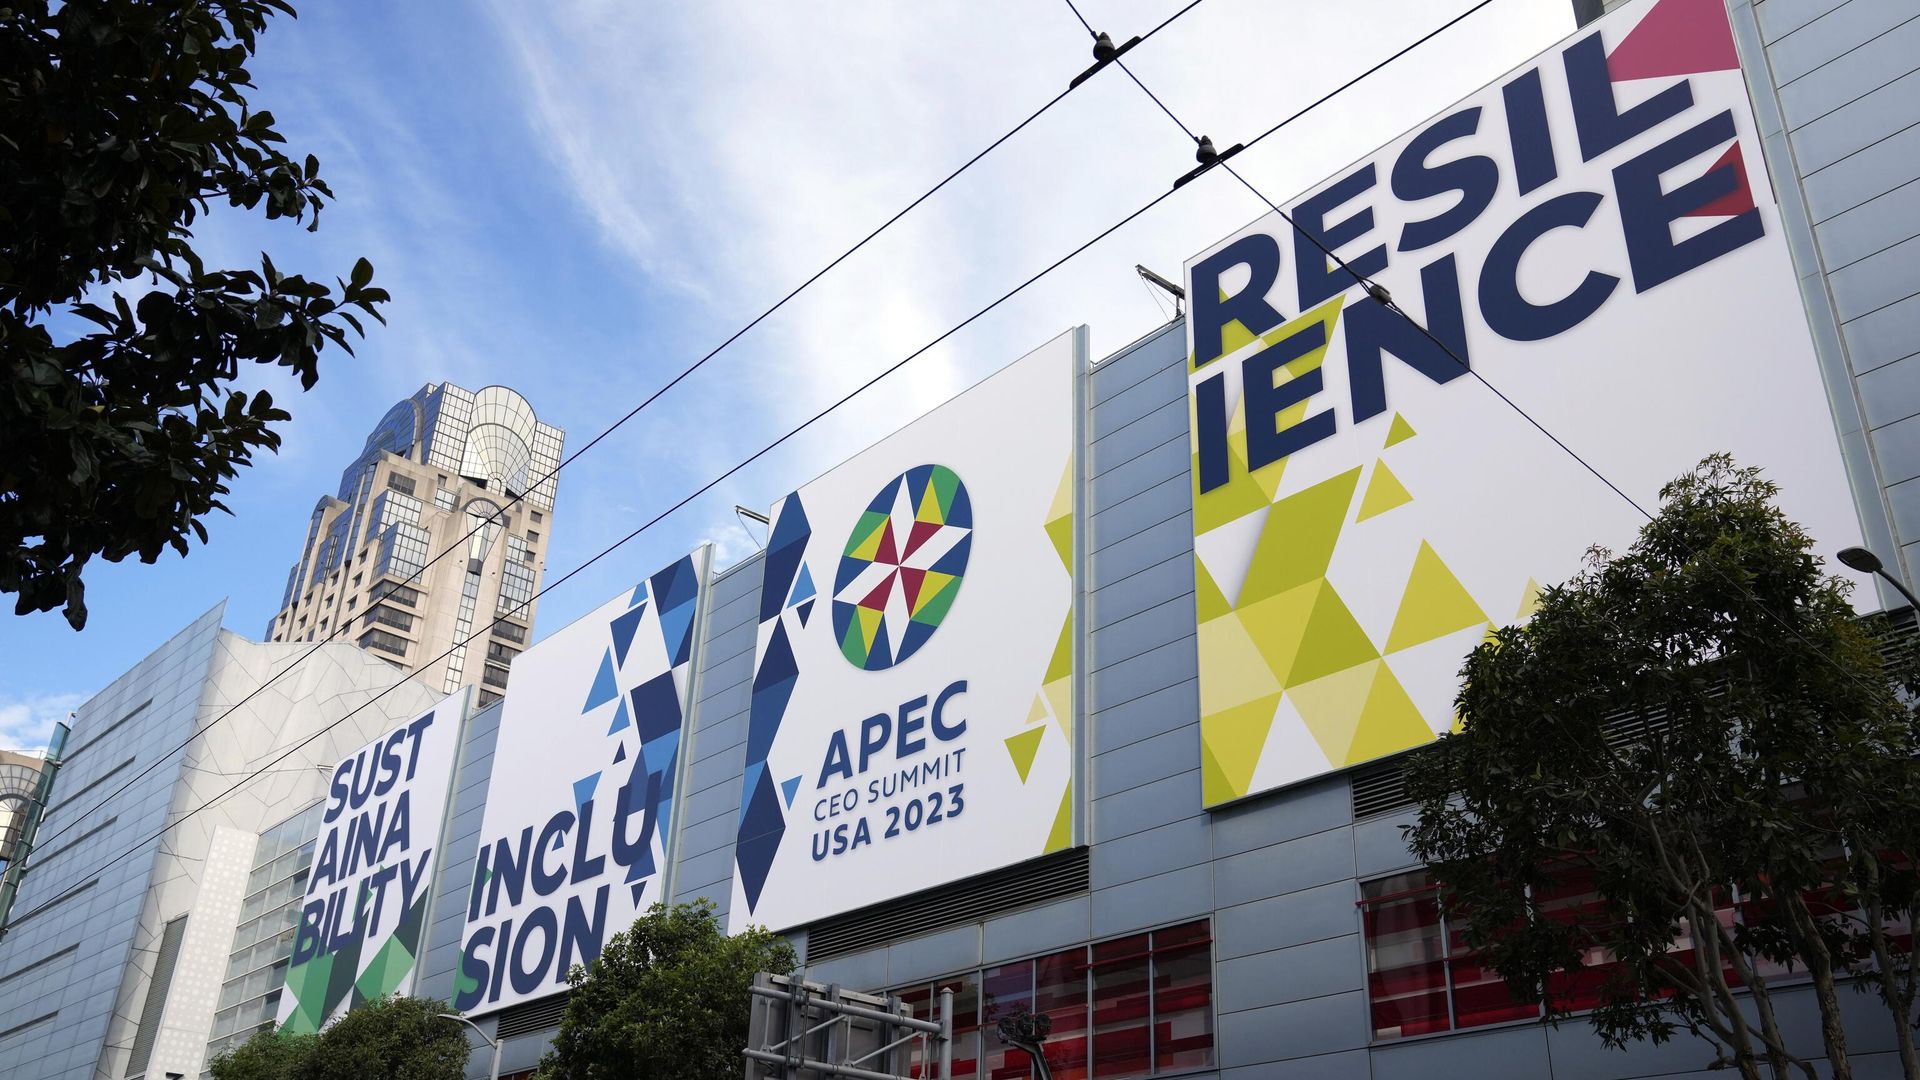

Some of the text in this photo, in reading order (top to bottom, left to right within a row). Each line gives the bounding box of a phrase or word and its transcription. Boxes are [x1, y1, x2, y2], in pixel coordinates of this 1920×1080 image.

[1191, 30, 1695, 368] RESIL
[1196, 109, 1765, 496] IENCE
[323, 711, 435, 824] SUST
[814, 748, 966, 822] CEO SUMMIT
[816, 680, 968, 789] APEC
[308, 790, 410, 895] AINA
[468, 770, 662, 923] INCLU
[812, 783, 965, 862] USA 2023
[291, 849, 430, 967] BILITY
[454, 884, 610, 1012] SION
